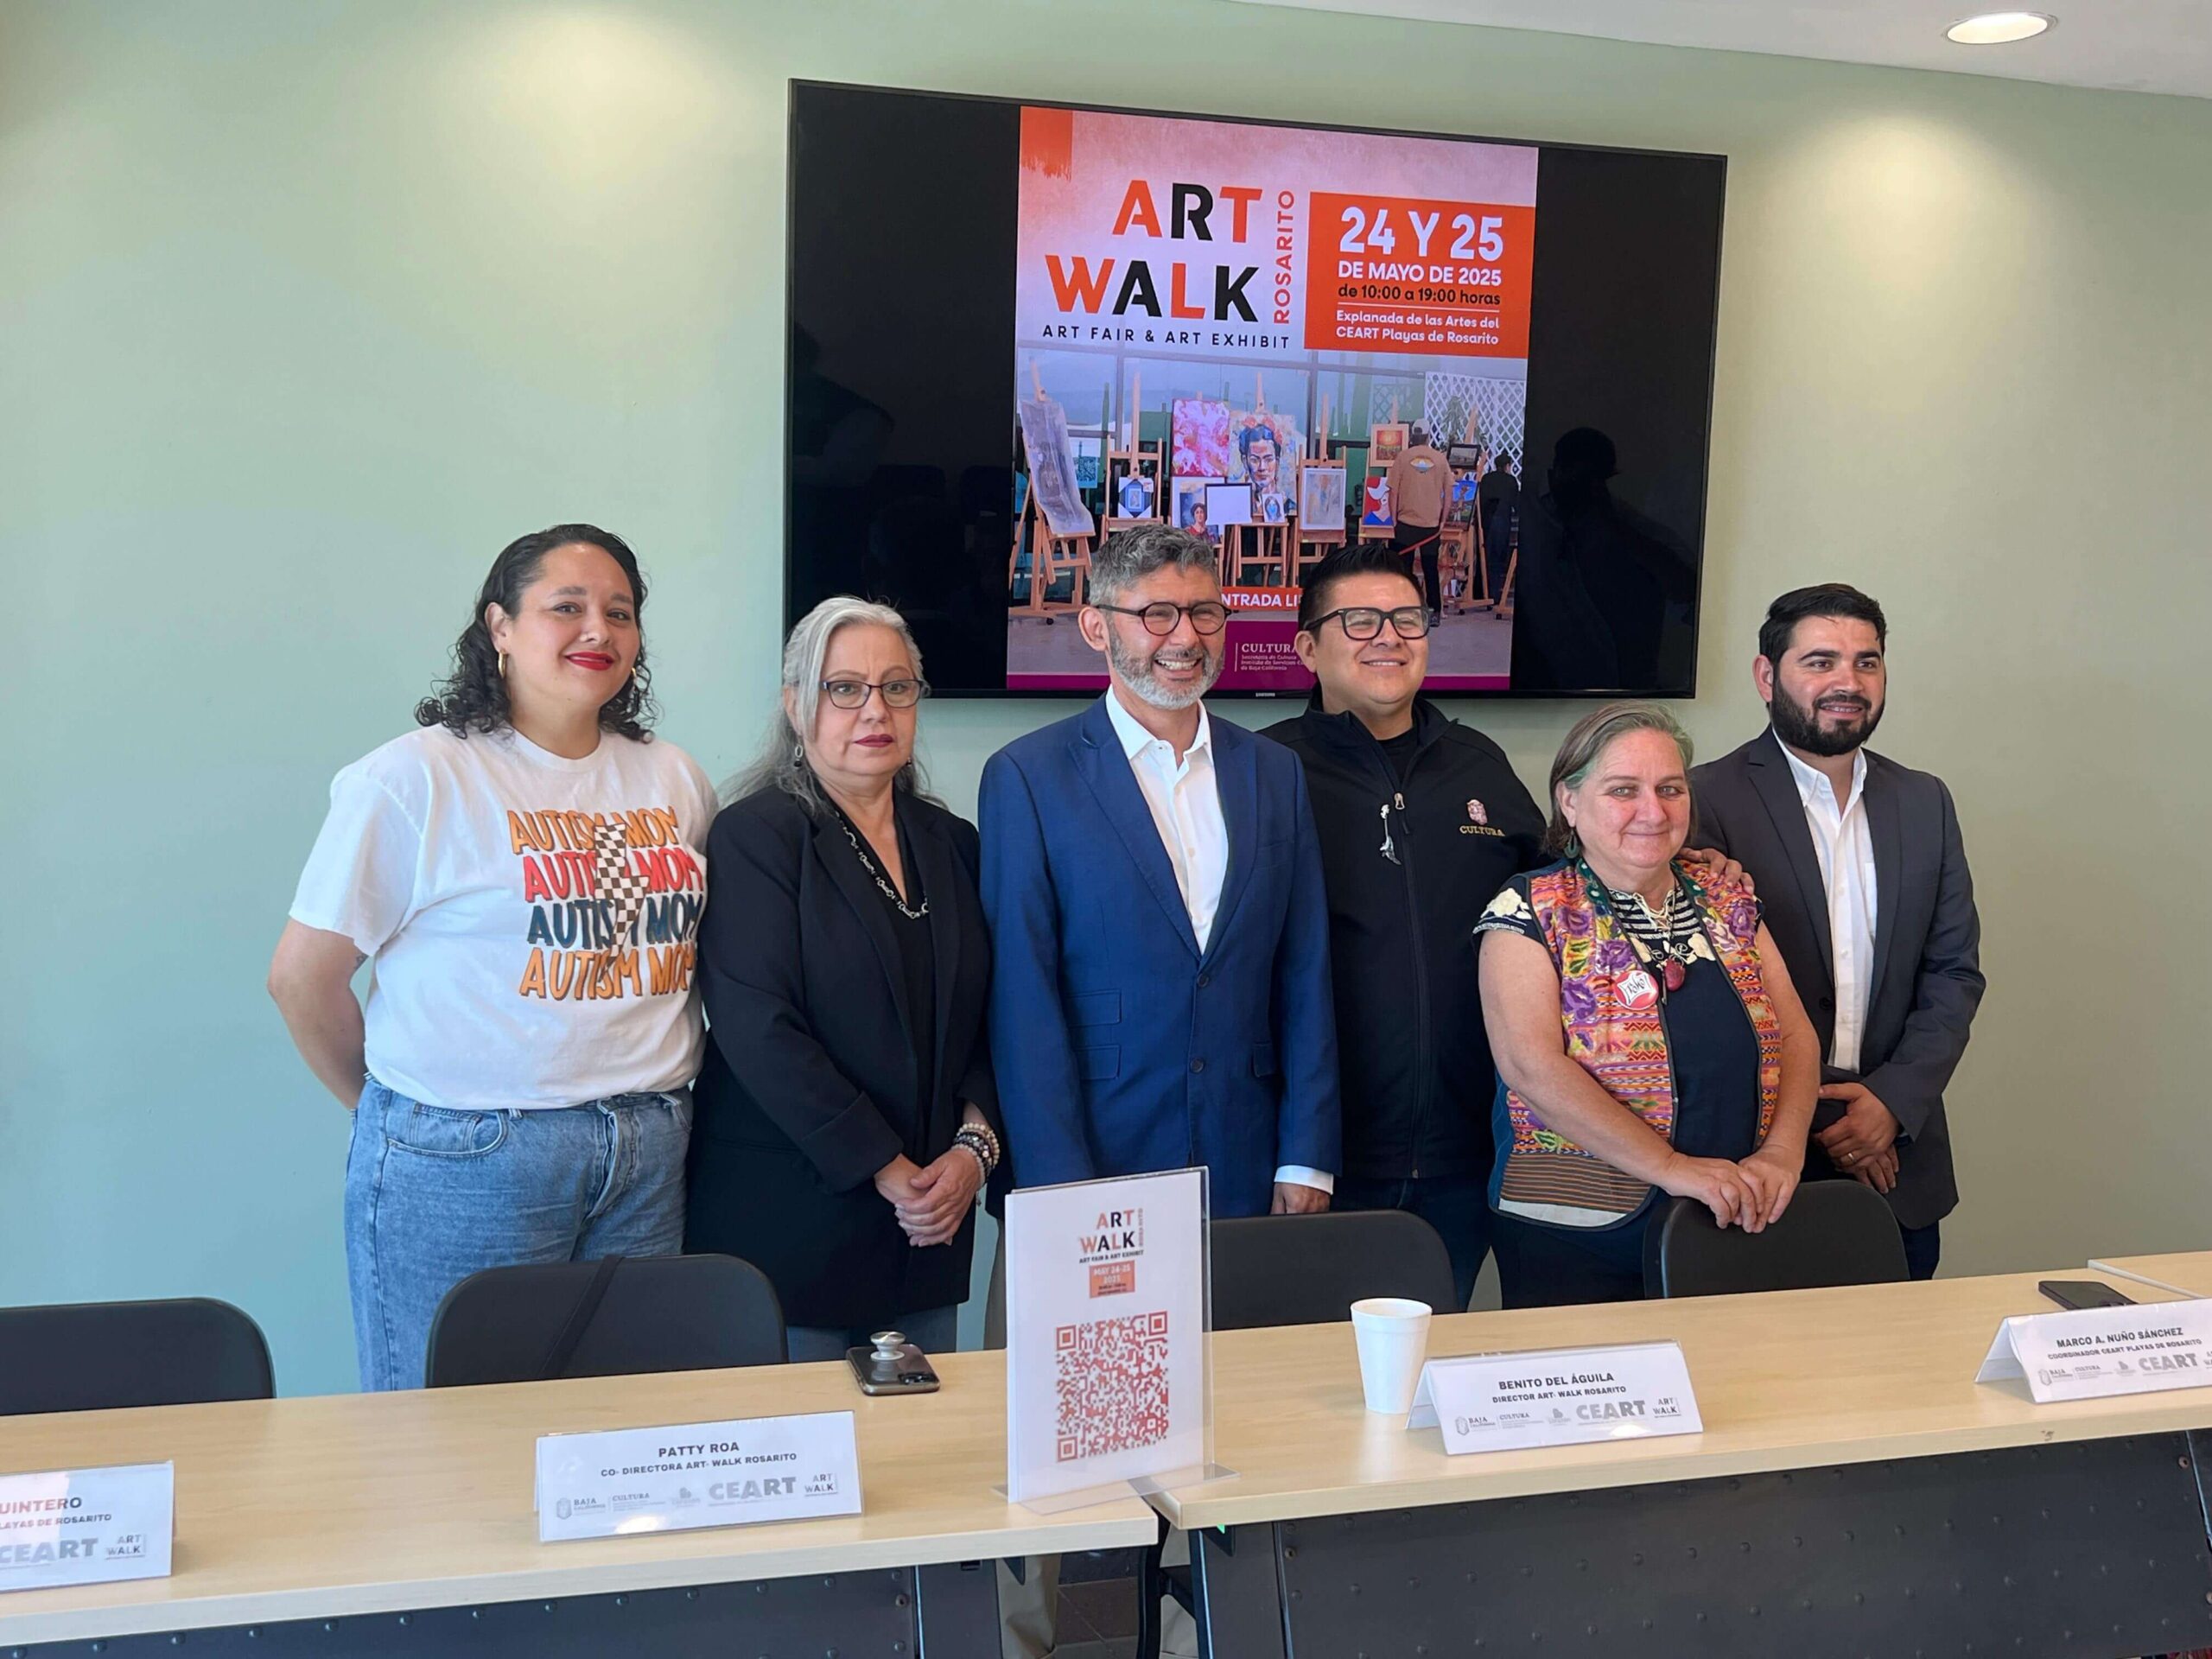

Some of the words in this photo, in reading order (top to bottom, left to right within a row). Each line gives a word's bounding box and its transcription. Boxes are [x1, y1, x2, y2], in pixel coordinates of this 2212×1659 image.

[1112, 180, 1262, 243] ART
[1339, 207, 1395, 255] 24
[1408, 211, 1440, 257] Y
[1450, 213, 1503, 262] 25
[1274, 190, 1294, 324] ROSARITO
[1338, 260, 1363, 278] DE
[1368, 263, 1425, 283] MAYO
[1429, 266, 1454, 283] DE
[1458, 268, 1502, 286] 2025
[1045, 254, 1260, 322] WALK
[1338, 284, 1358, 297] de
[1362, 285, 1402, 300] 10:00
[1404, 289, 1414, 300] a
[1418, 289, 1456, 302] 19:00
[1459, 289, 1501, 304] horas
[1337, 309, 1404, 325] Explanada
[1406, 312, 1422, 325] de
[1425, 314, 1443, 326] las
[1445, 315, 1478, 328] Artes
[1479, 316, 1500, 329] del
[1042, 324, 1080, 339] ART
[1090, 327, 1135, 341] FAIR
[1144, 329, 1154, 342] &
[1165, 331, 1201, 344] ART
[1211, 334, 1290, 349] EXHIBIT
[1336, 327, 1379, 339] CEART
[1382, 328, 1425, 344] Playas
[1427, 331, 1444, 342] de
[1447, 332, 1499, 345] Rosarito
[1221, 594, 1283, 607] NTRADA
[1285, 594, 1302, 607] LI
[1459, 825, 1506, 836] CULTURA
[1096, 1209, 1135, 1230] ART
[1080, 1230, 1135, 1255] WALK
[2056, 1336, 2092, 1348] MARCO
[2095, 1335, 2105, 1344] A.
[2107, 1331, 2135, 1344] NUÑO
[2138, 1326, 2183, 1340] SÁNCHEZ
[2139, 1353, 2198, 1371] CEART
[1499, 1377, 1543, 1390] BENITO
[1545, 1376, 1568, 1387] DEL
[1571, 1372, 1615, 1384] ÁGUILA
[1492, 1393, 1535, 1403] DIRECTOR
[1558, 1389, 1582, 1397] WALK
[1584, 1385, 1627, 1395] ROSARITO
[1575, 1400, 1645, 1420] CEART
[1653, 1406, 1678, 1415] WALK
[658, 1444, 705, 1458] PATTY
[709, 1441, 740, 1453] ROA
[622, 1462, 683, 1475] DIRECTORA
[712, 1457, 742, 1467] WALK
[745, 1452, 798, 1464] ROSARITO
[812, 1473, 833, 1483] ART
[612, 1492, 650, 1502] CULTURA
[709, 1477, 797, 1501] CEART
[804, 1484, 834, 1492] WALK
[0, 1497, 82, 1515] UINTERO
[0, 1518, 34, 1529] LAYAS
[37, 1517, 53, 1526] DE
[55, 1513, 111, 1524] ROSARITO
[118, 1535, 142, 1544] ART
[0, 1538, 99, 1562] CEART
[107, 1546, 141, 1555] WALK
